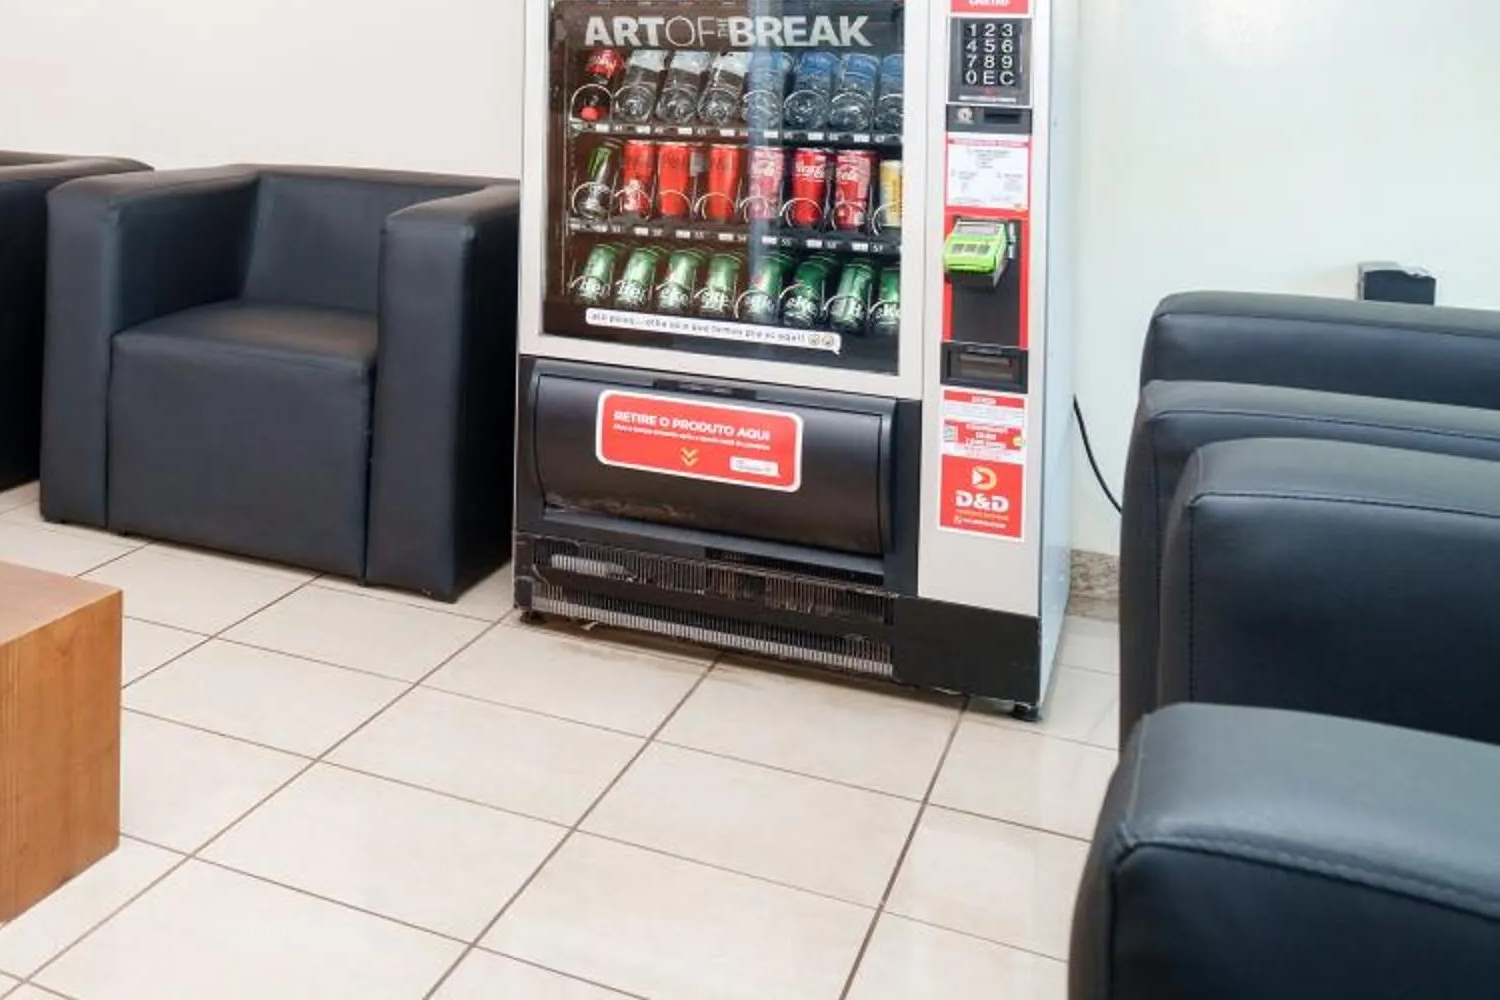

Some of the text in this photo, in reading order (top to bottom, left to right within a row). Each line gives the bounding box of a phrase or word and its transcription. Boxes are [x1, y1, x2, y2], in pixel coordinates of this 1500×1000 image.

[585, 15, 665, 47] ART
[665, 15, 717, 47] OF
[729, 15, 873, 48] BREAK
[968, 23, 1013, 37] 1 2 3
[966, 39, 1013, 53] 4 5 6
[966, 55, 1013, 69] 7 8 9
[983, 71, 995, 85] E
[1000, 71, 1015, 85] C
[613, 410, 658, 425] RETIRE
[659, 416, 671, 428] O
[672, 416, 736, 436] PRODUTO
[736, 427, 771, 441] AQUI
[955, 490, 1010, 513] D&D
